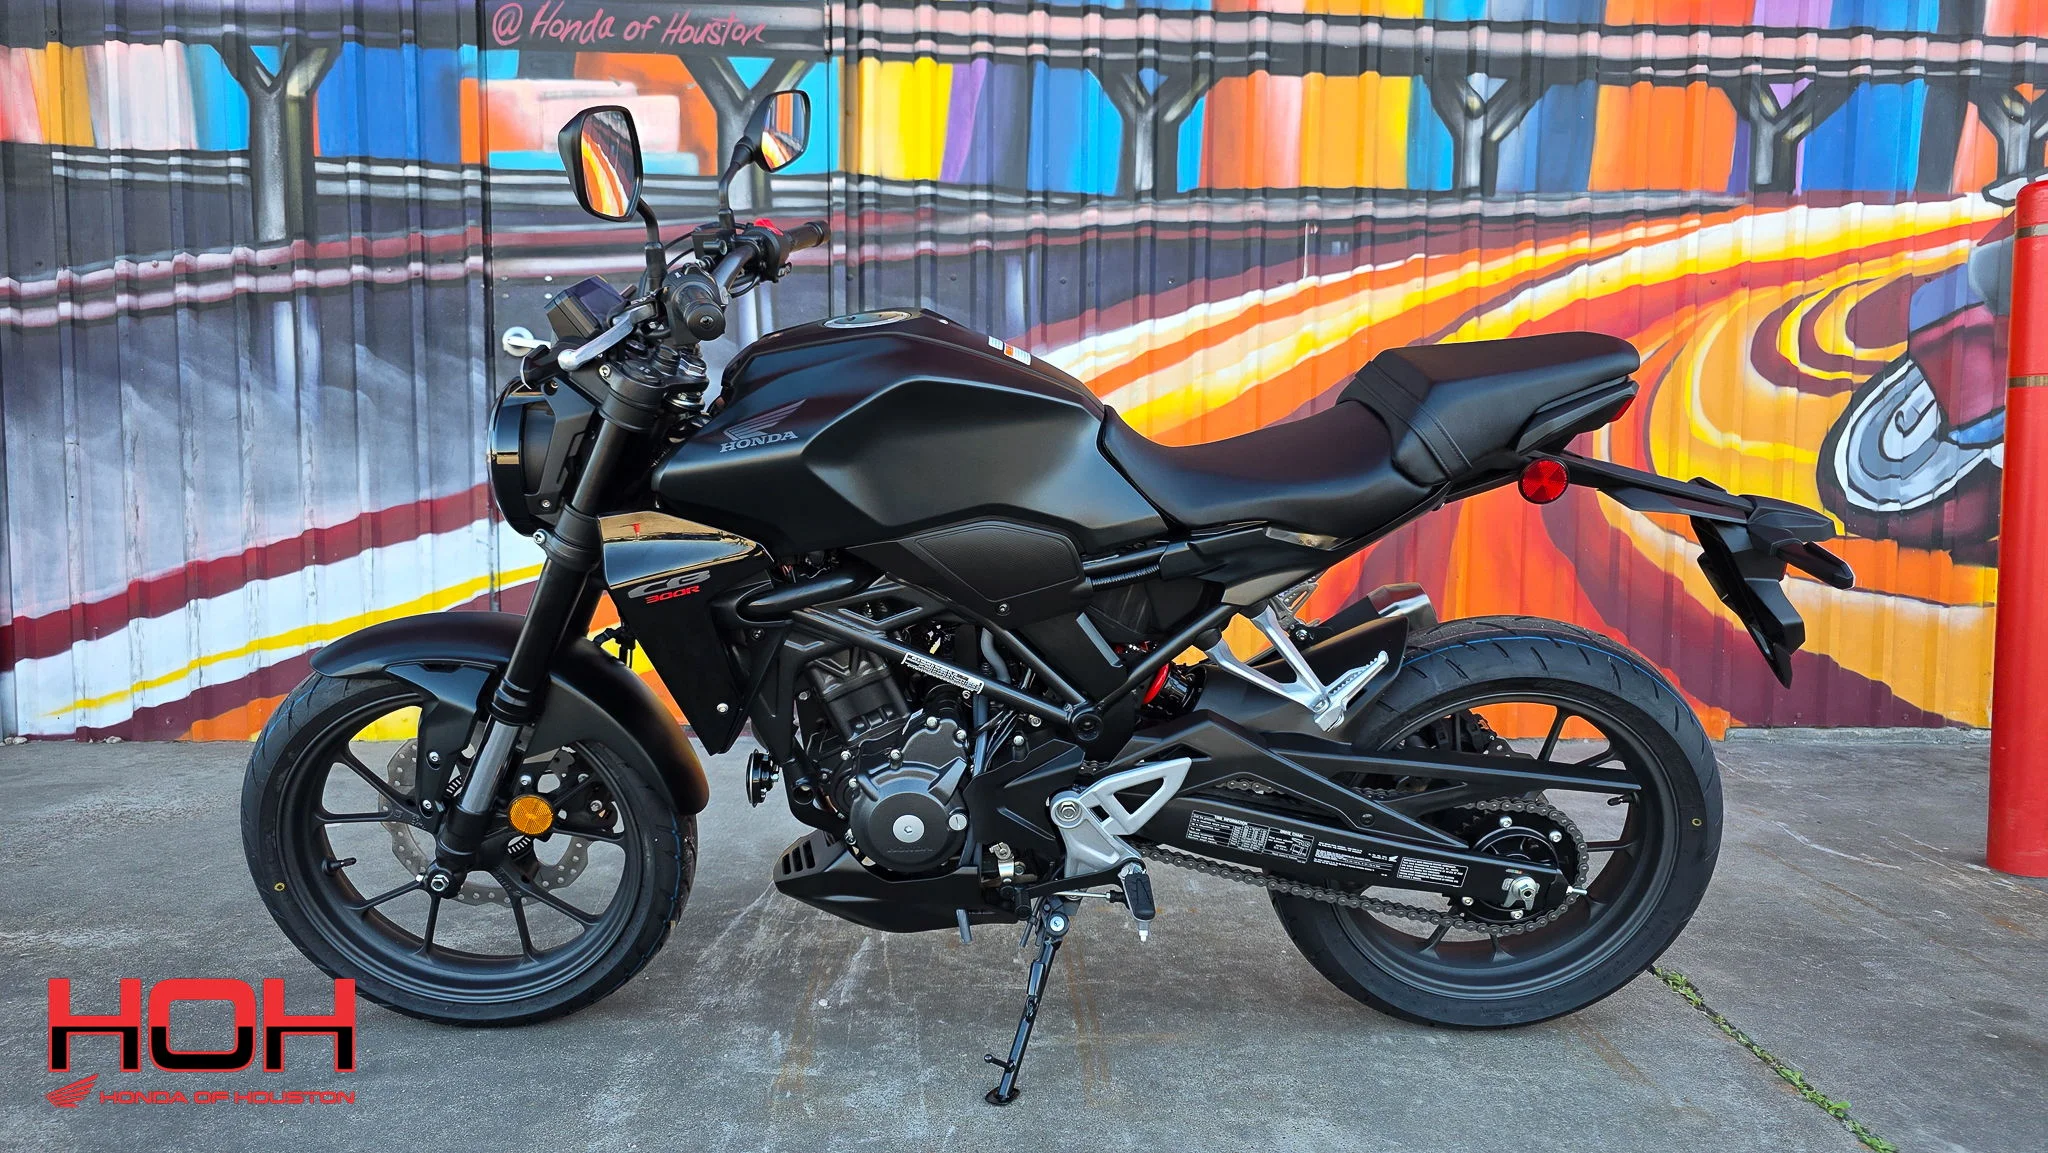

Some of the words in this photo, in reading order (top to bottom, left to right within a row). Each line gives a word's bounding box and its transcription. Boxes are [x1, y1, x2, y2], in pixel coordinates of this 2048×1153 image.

[492, 2, 523, 46] @
[530, 0, 615, 45] Honda
[623, 15, 661, 41] of
[661, 10, 768, 47] Houston
[720, 430, 798, 453] HONDA
[628, 570, 711, 599] CB
[644, 585, 701, 604] 300R
